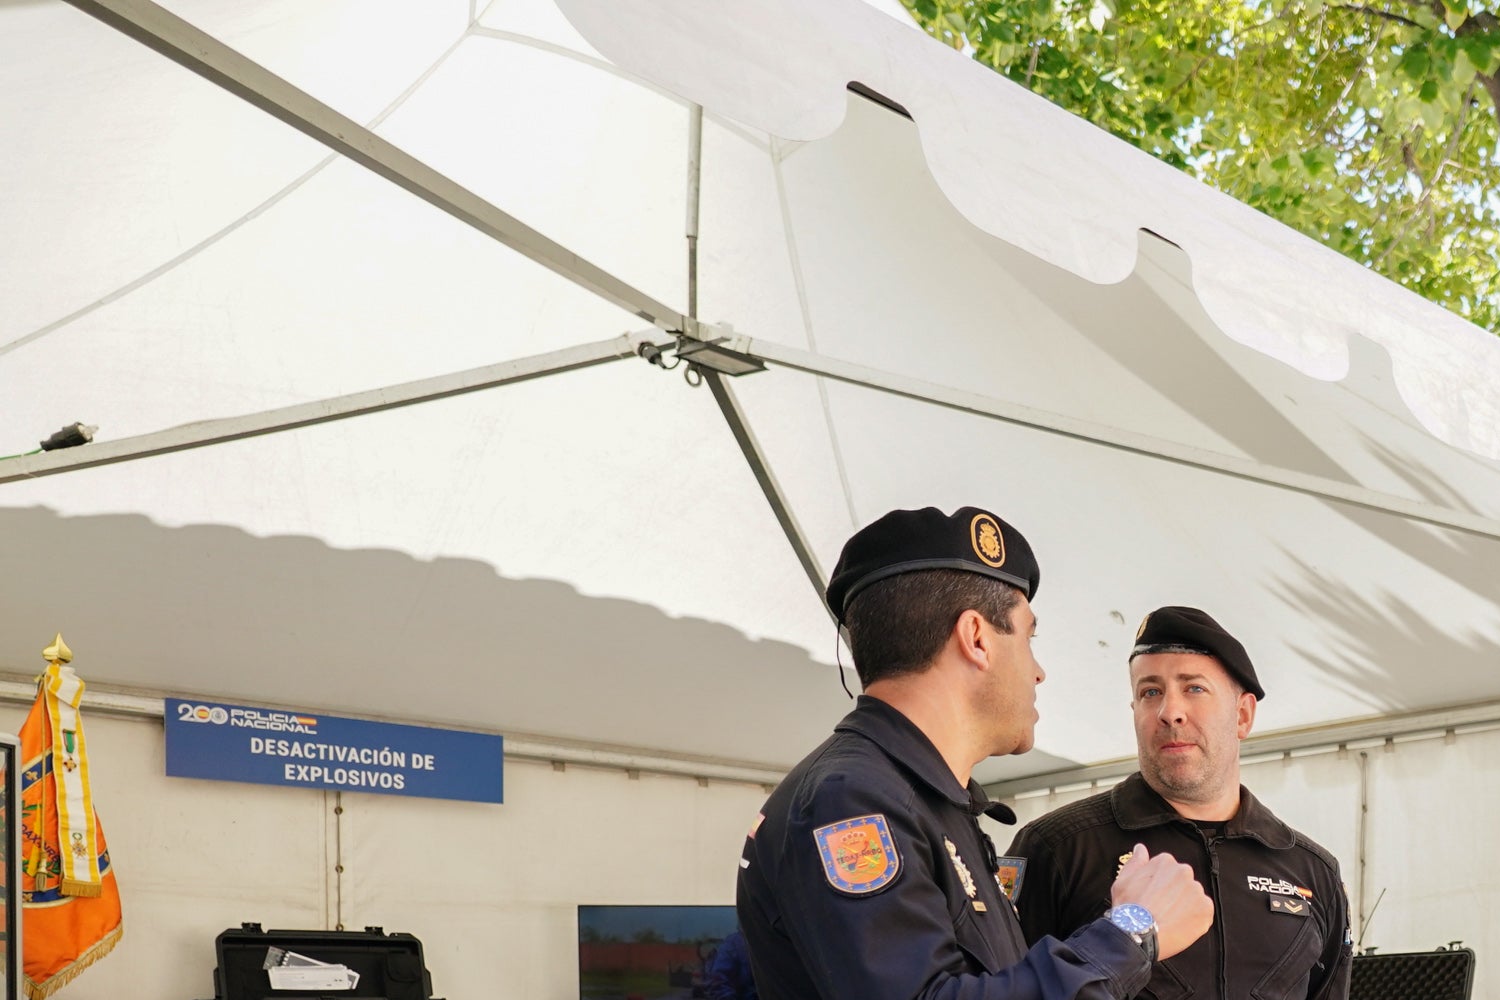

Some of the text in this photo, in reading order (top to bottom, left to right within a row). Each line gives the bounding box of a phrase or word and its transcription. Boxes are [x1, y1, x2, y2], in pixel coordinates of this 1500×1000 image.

[178, 703, 228, 724] 200
[231, 709, 299, 724] POLICIA
[231, 718, 317, 735] NACIONAL
[250, 737, 435, 770] DESACTIVACIÓN DE
[285, 763, 405, 789] EXPLOSIVOS
